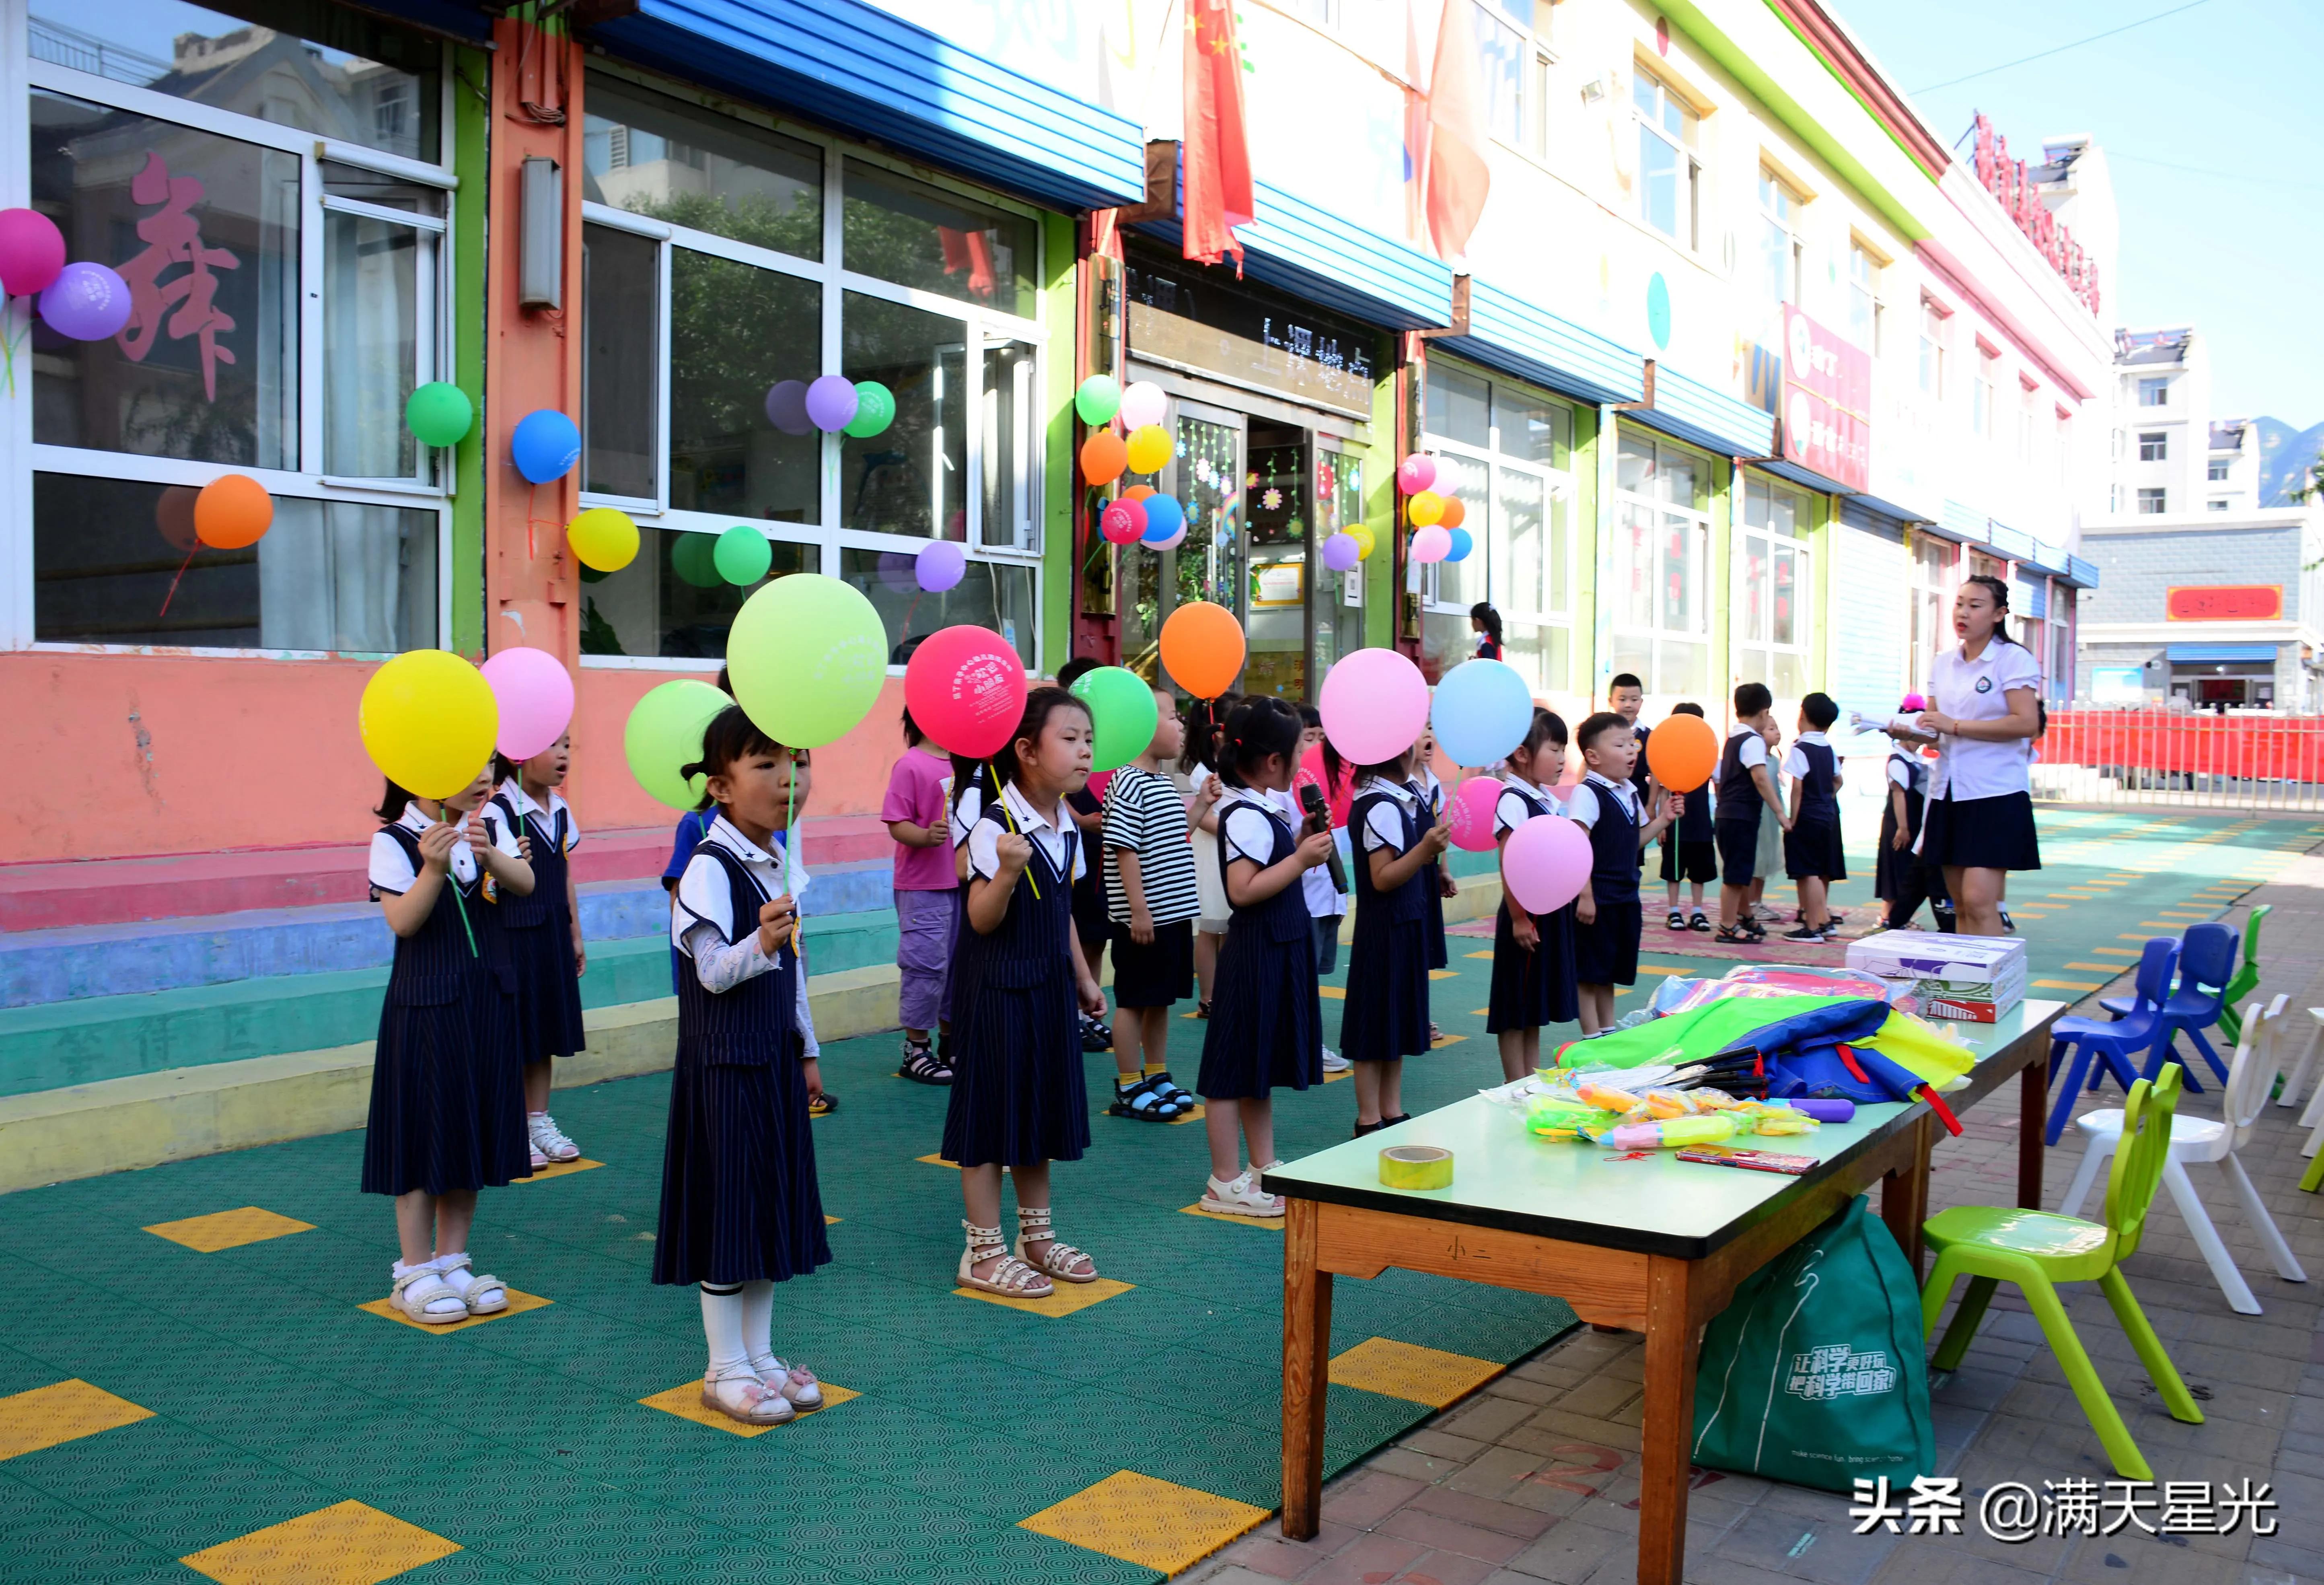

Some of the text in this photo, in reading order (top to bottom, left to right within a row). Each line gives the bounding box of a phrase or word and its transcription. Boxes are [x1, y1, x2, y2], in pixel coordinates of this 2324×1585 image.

[113, 152, 241, 403] 舞
[1794, 1347, 1884, 1373] 让科学更好玩
[1791, 1449, 1808, 1457] make
[1809, 1452, 1832, 1460] science
[1849, 1455, 1864, 1464] bring
